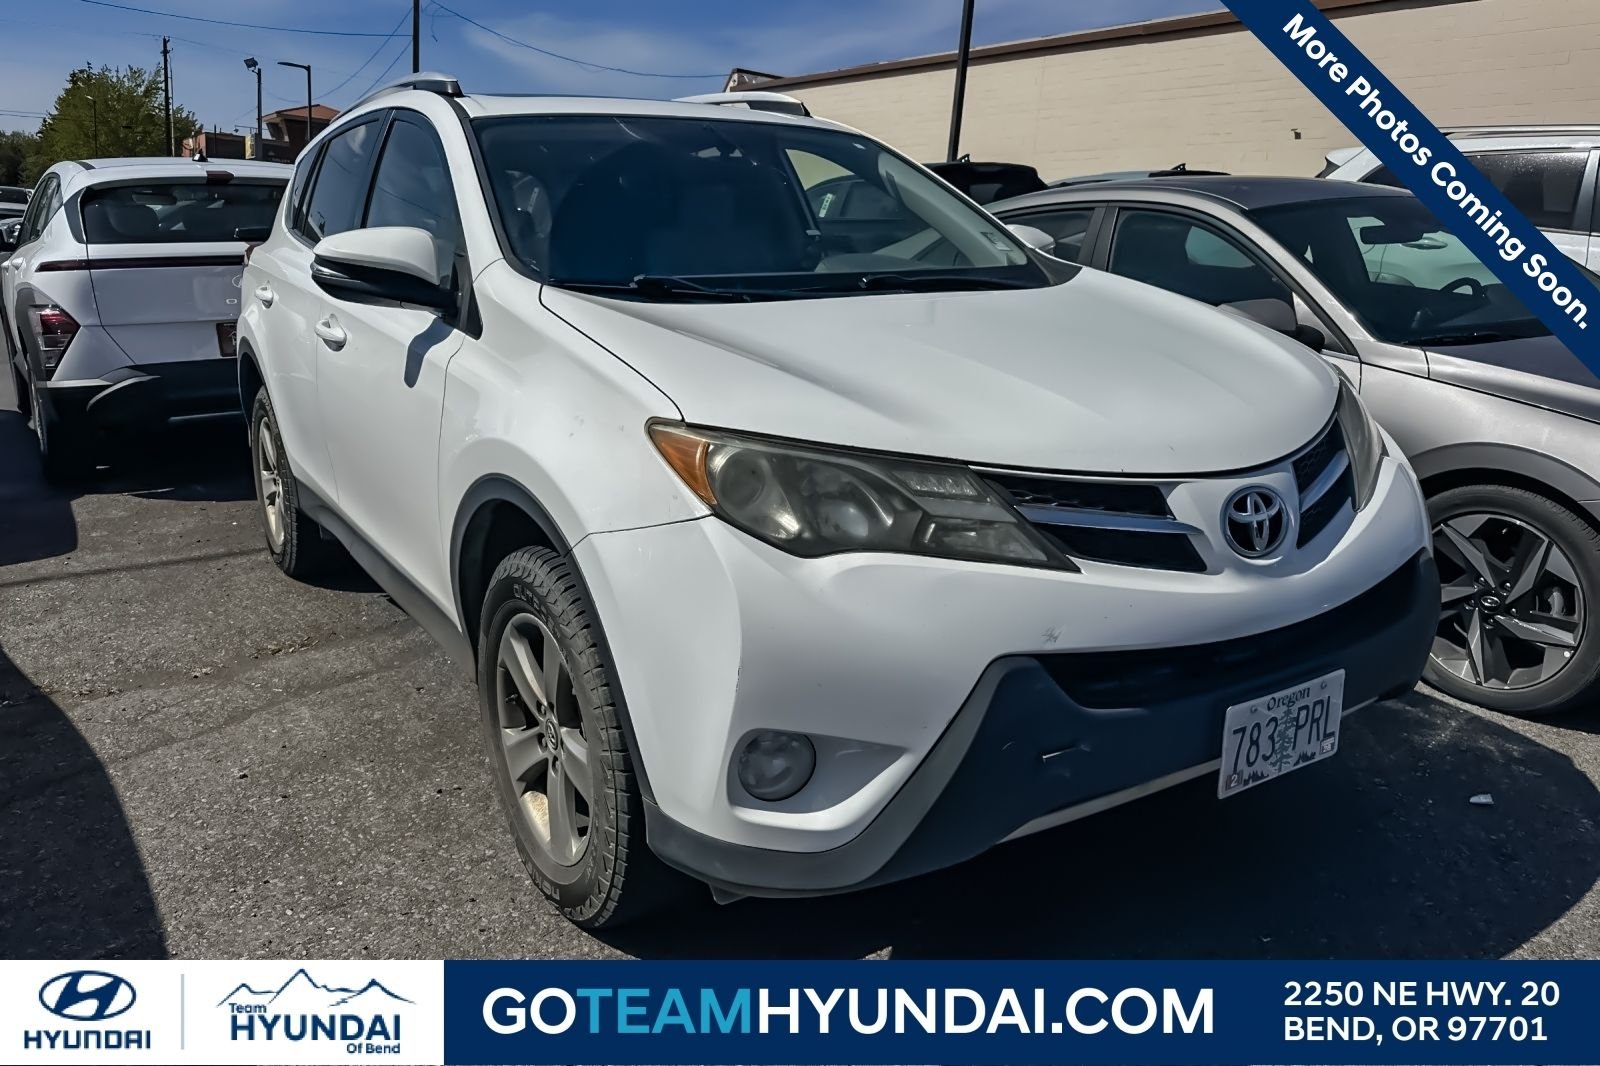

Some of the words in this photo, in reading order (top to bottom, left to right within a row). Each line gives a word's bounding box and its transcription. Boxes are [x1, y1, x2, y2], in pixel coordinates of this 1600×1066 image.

[1266, 686, 1311, 711] Oregon
[1232, 716, 1279, 775] 783
[1291, 695, 1336, 751] PRL
